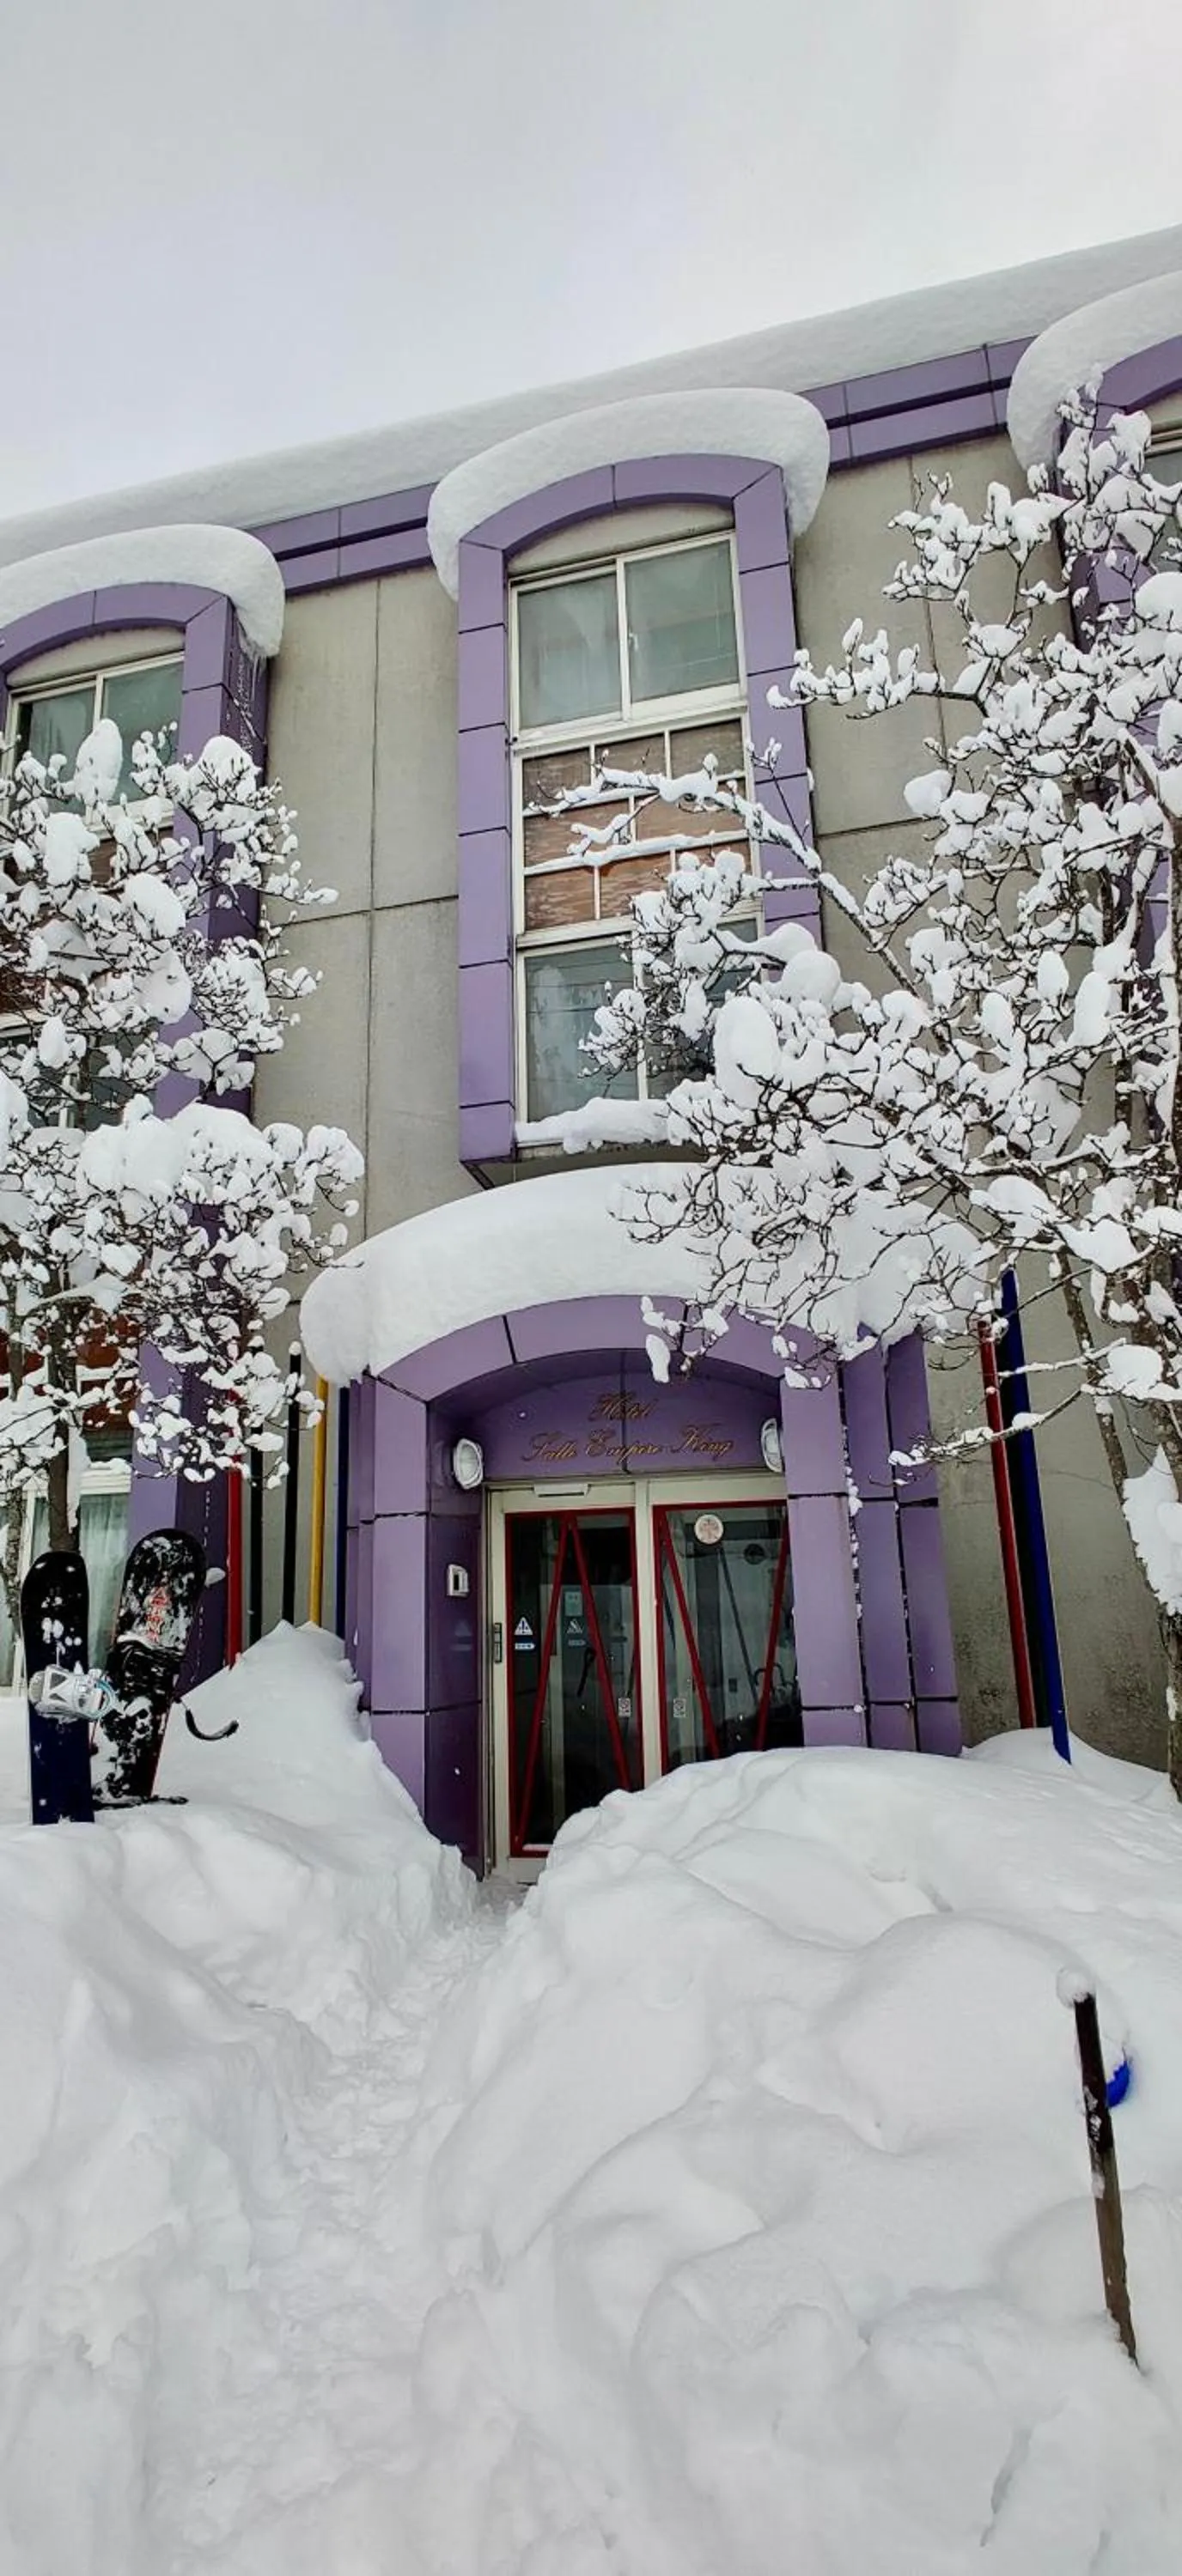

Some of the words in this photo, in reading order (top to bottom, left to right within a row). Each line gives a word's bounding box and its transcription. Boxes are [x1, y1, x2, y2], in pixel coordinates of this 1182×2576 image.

[588, 1390, 659, 1422] Hotel
[585, 1428, 662, 1465] Empire
[672, 1423, 735, 1461] King
